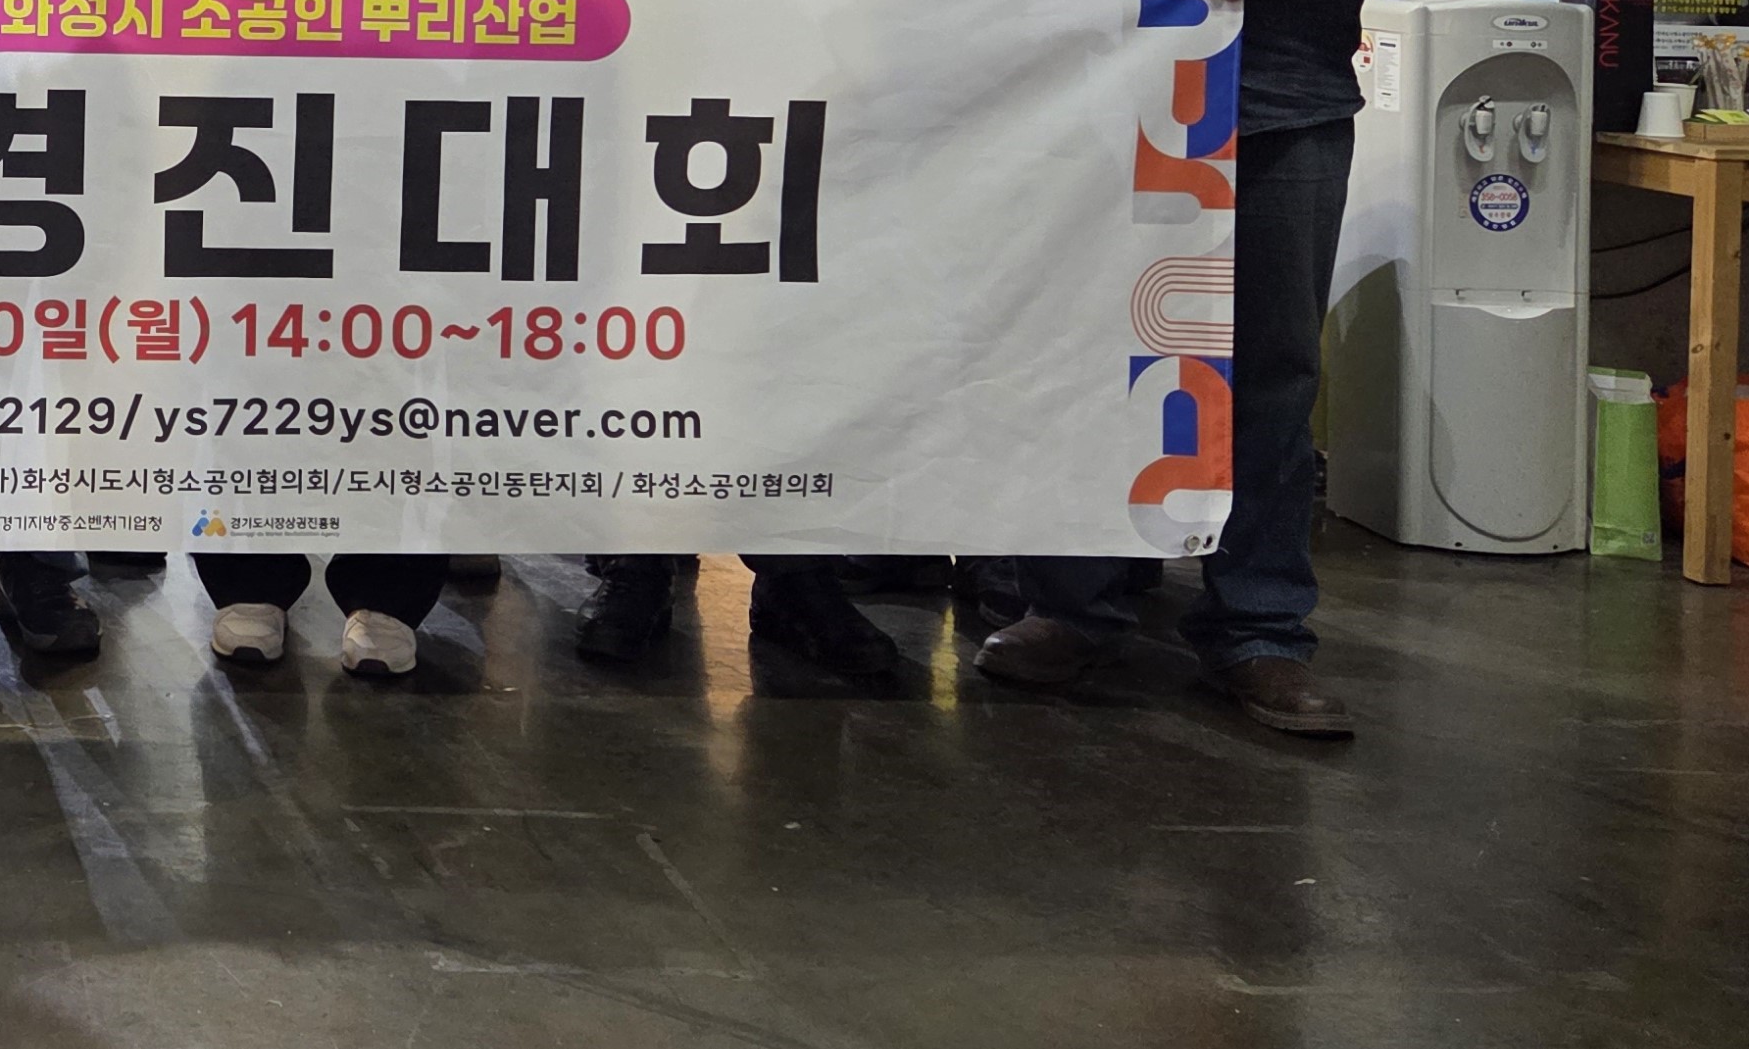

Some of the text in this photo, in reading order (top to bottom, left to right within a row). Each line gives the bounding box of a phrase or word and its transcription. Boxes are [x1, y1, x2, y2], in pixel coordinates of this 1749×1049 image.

[232, 303, 685, 362] 14:00~18:00
[632, 471, 834, 499] 화성소공인협의회
[0, 514, 162, 532] 경기지방중소벤처기업청
[230, 516, 341, 530] 경기도시장상권진흥원
